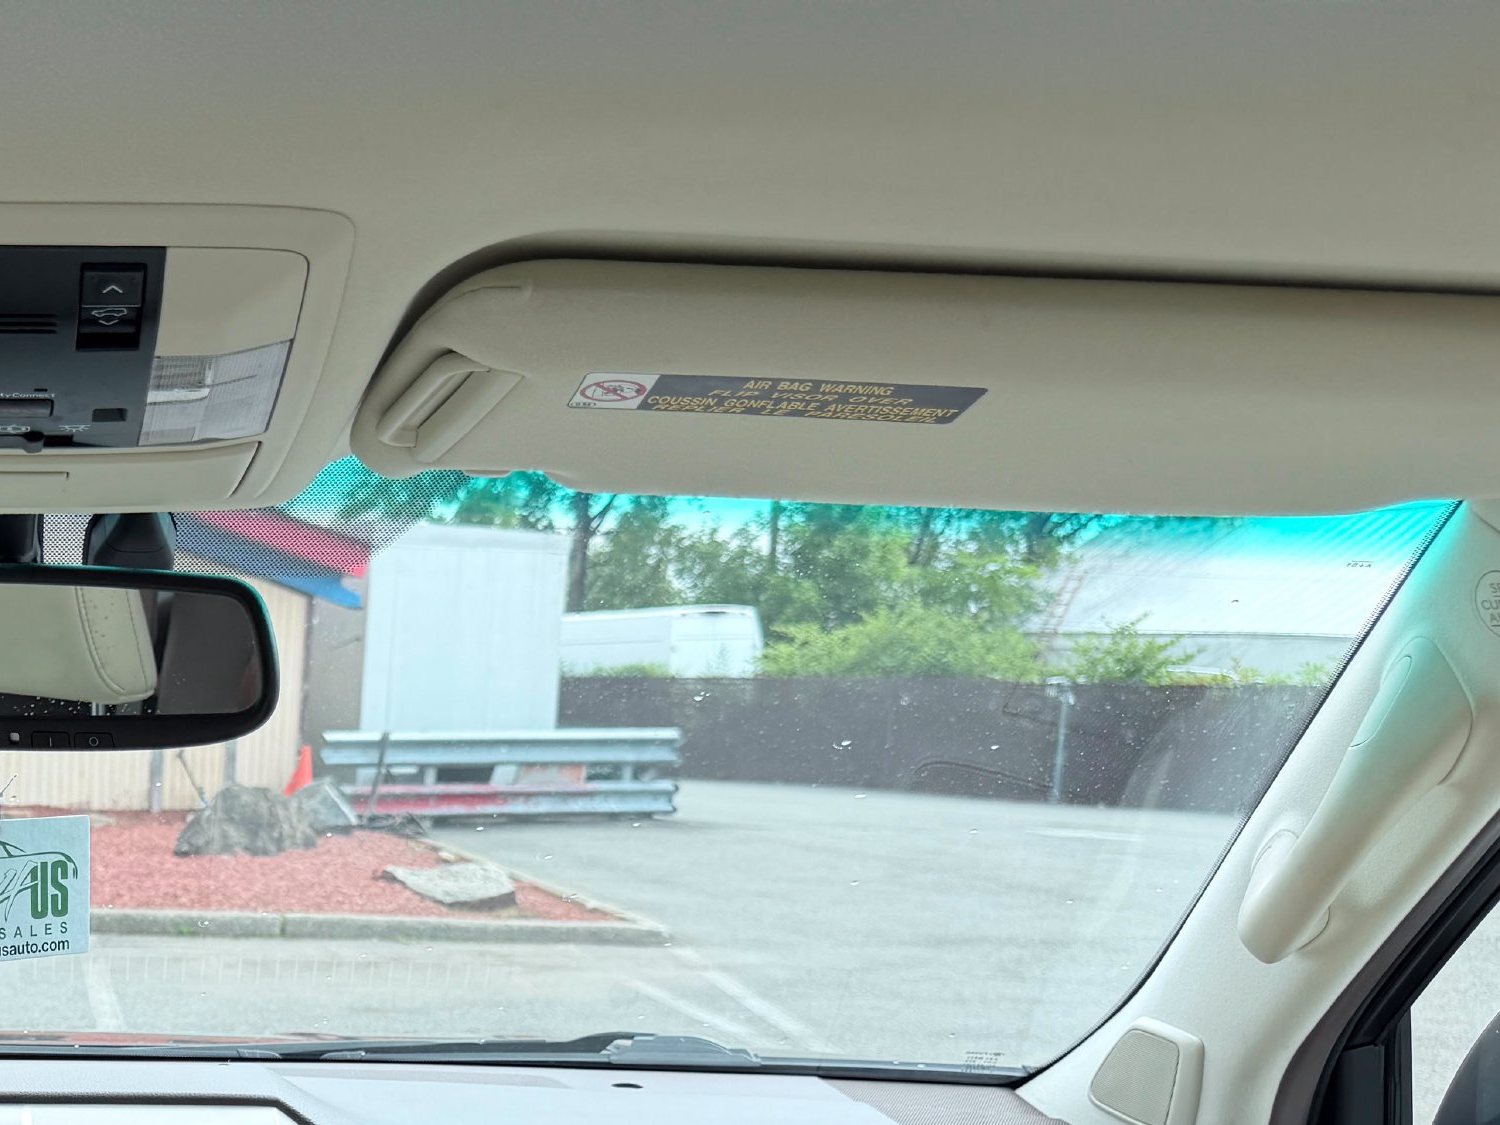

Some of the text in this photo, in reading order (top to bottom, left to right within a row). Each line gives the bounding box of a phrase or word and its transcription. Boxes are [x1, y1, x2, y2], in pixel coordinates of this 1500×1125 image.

[743, 379, 896, 396] AIR BAG WARNING
[708, 389, 914, 405] FLIP VISOR OVER
[647, 395, 718, 406] COUSSIN
[823, 402, 960, 418] AVERTISSEMENT
[652, 404, 941, 424] REPLIER LE PARESOLEIL
